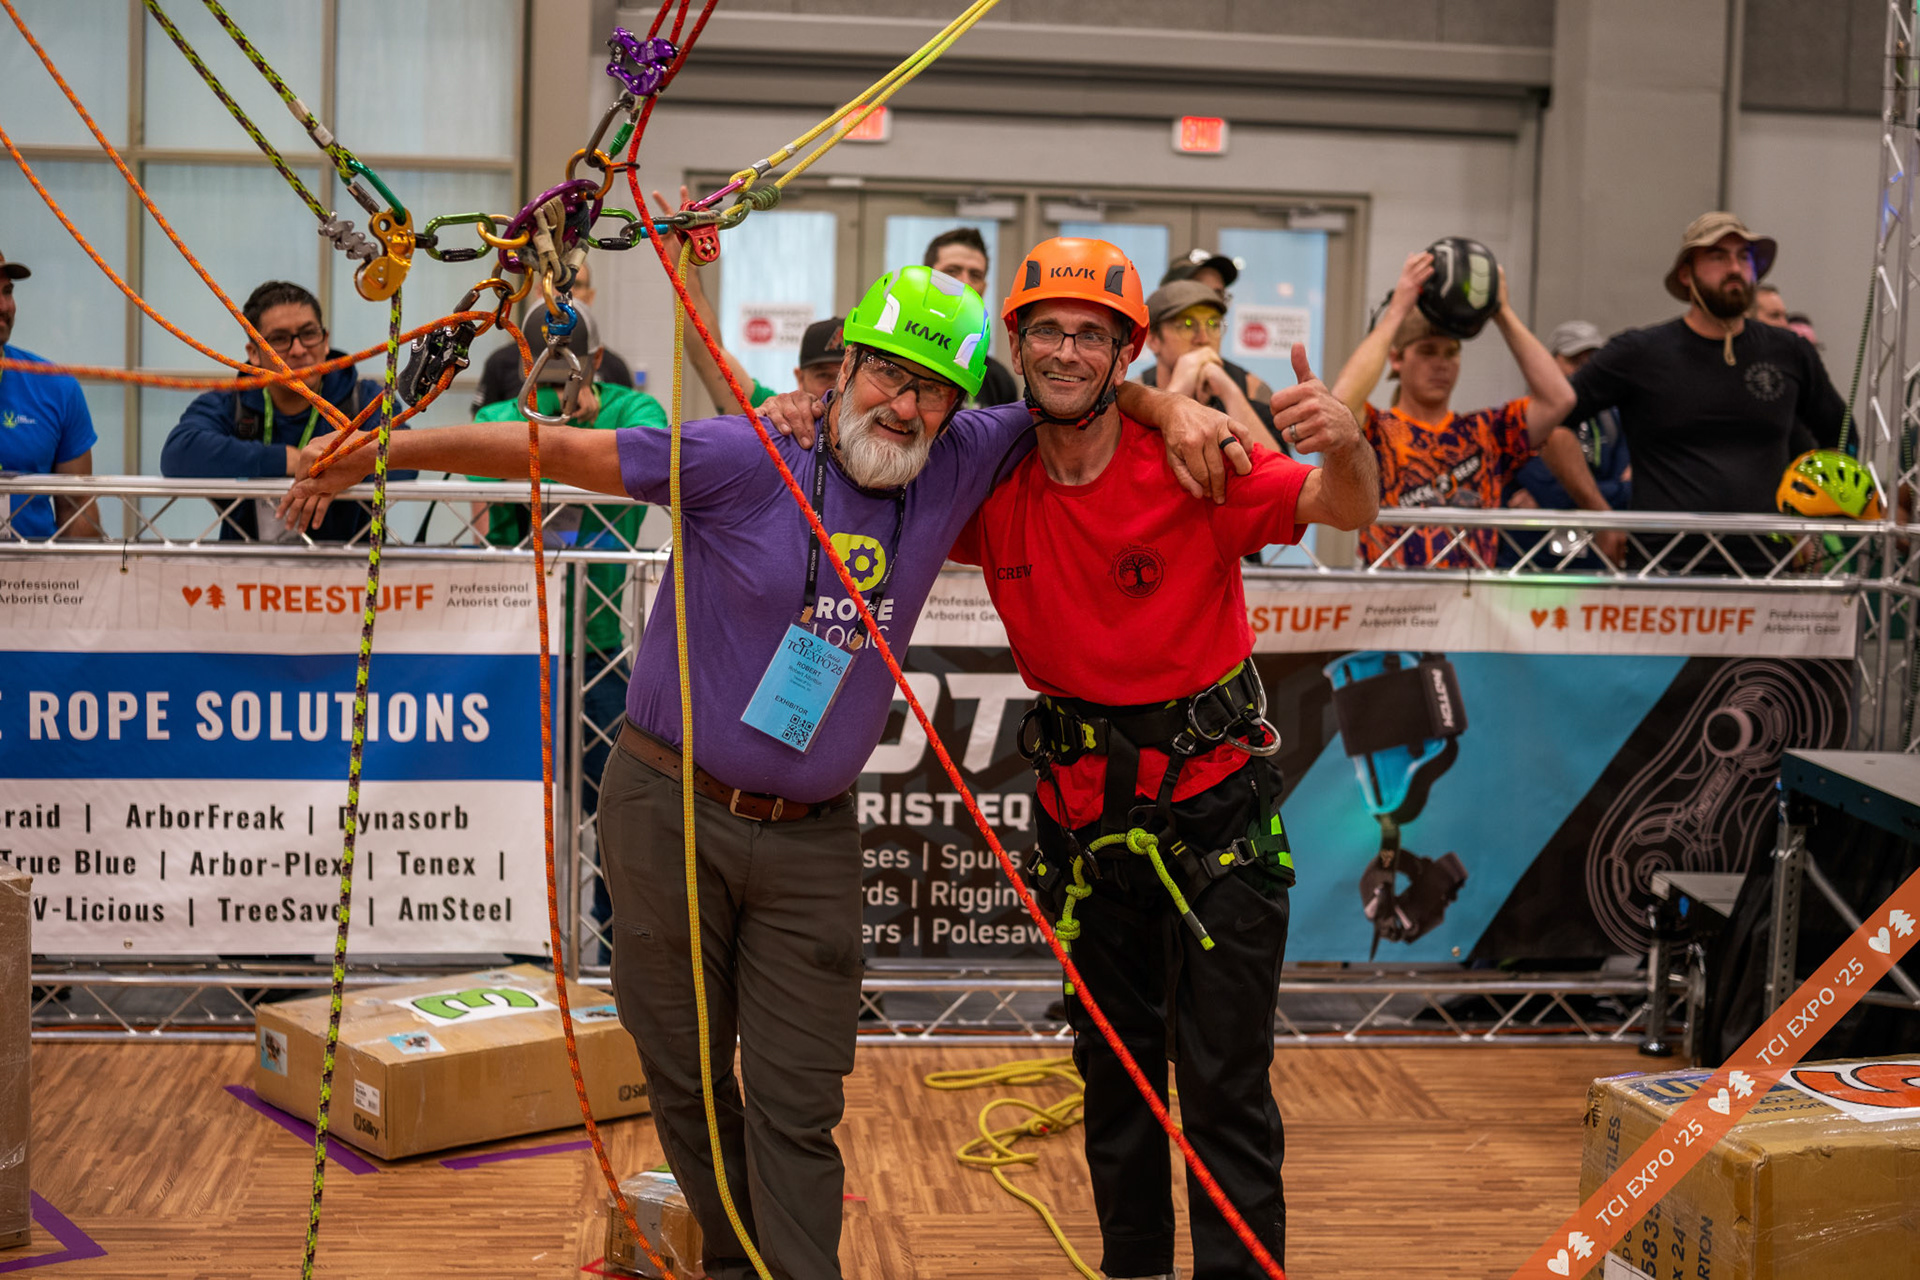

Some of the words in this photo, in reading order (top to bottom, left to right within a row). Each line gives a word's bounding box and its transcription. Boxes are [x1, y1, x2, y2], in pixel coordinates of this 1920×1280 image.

[1050, 266, 1096, 281] KASK
[904, 320, 952, 350] KASK
[996, 564, 1033, 581] CREW
[0, 579, 80, 591] Professional
[449, 582, 529, 594] Professional
[53, 593, 84, 606] Gear
[236, 583, 434, 614] TREESTUFF
[446, 596, 499, 608] Arborist
[502, 597, 532, 608] Gear
[925, 611, 976, 622] Arborist
[1365, 603, 1437, 615] Professional
[1769, 608, 1839, 621] Professional
[1246, 604, 1352, 634] STUFF
[1359, 616, 1409, 629] Arborist
[1411, 616, 1439, 628] Gear
[1580, 604, 1756, 635] TREESTUFF
[1764, 623, 1810, 635] Arborist
[1814, 624, 1841, 636] Gear
[796, 661, 822, 677] ROBERT
[774, 694, 809, 716] EXHIBITOR
[29, 690, 170, 741] ROPE
[196, 690, 490, 743] SOLUTIONS
[0, 803, 61, 829] raid
[126, 803, 285, 830] ArborFreak
[857, 792, 963, 826] RIST
[75, 849, 137, 875] Blue
[189, 850, 342, 877] Arbor-Plex
[397, 850, 476, 876] Tenex
[862, 880, 900, 906] ds
[34, 896, 165, 922] V-Licious
[218, 896, 341, 923] TreeSave
[399, 896, 512, 923] AmSteel
